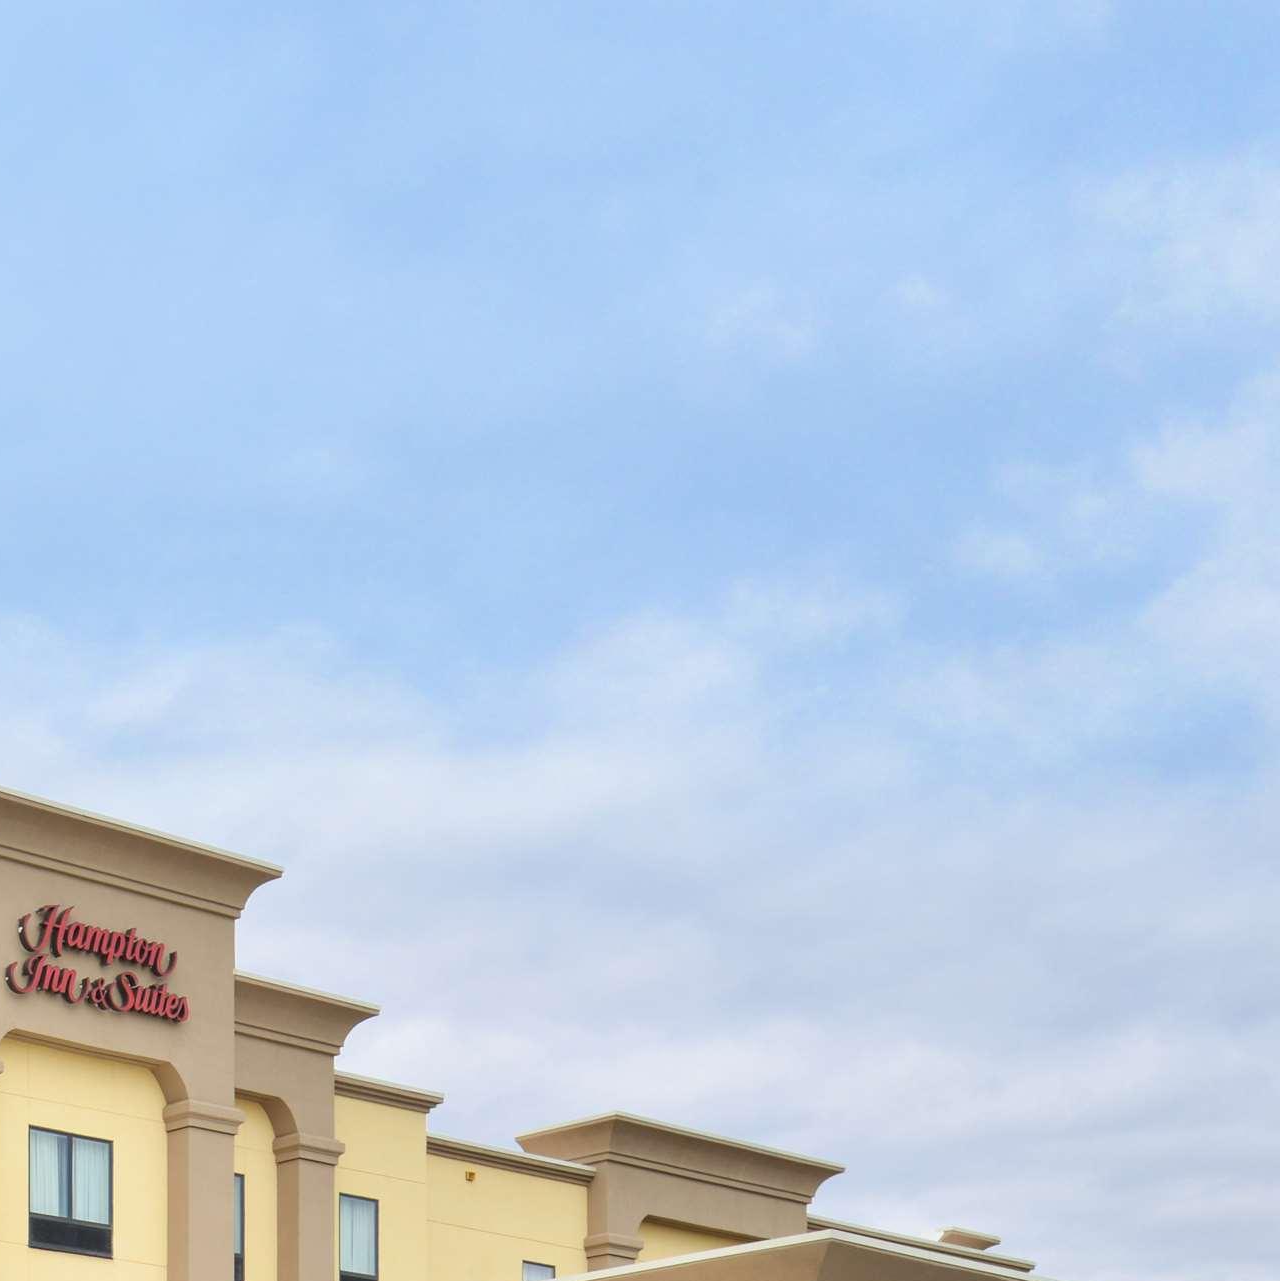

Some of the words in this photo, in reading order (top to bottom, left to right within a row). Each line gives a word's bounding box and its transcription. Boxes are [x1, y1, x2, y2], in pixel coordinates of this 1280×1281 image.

[18, 904, 178, 978] Hampton
[5, 953, 91, 1004] Inn
[89, 976, 108, 1011] &
[104, 970, 190, 1024] Suites
